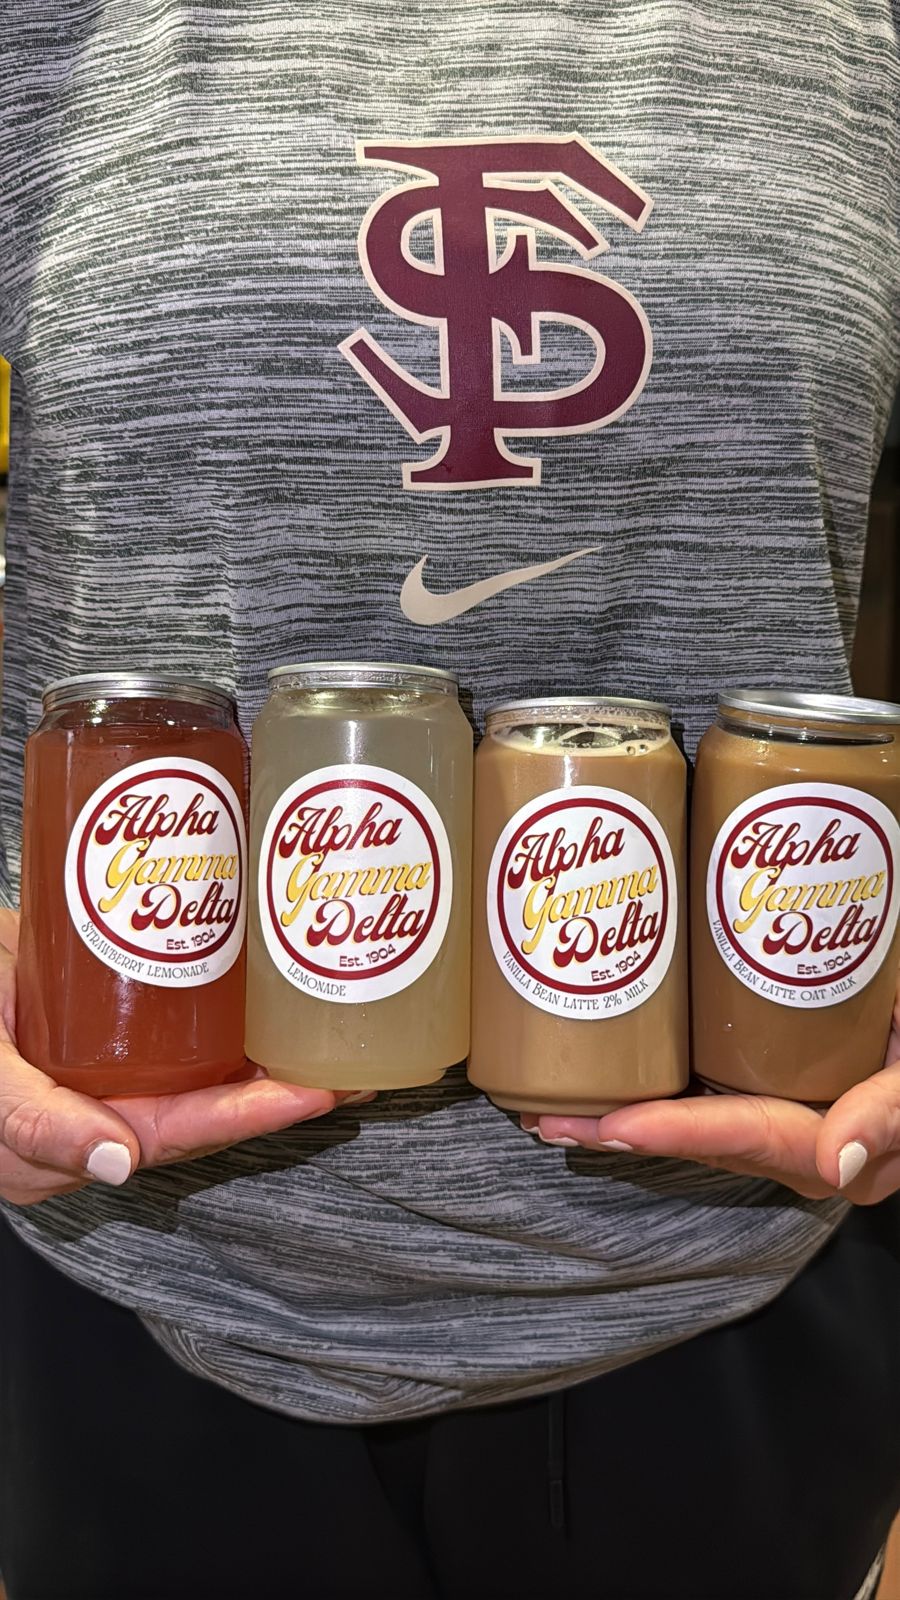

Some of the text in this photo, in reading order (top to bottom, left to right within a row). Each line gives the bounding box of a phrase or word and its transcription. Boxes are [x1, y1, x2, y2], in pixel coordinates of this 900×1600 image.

[94, 794, 219, 857] Alpha
[278, 802, 403, 869] Alpha
[507, 816, 625, 893] Alpha
[730, 818, 861, 884] Alpha
[98, 839, 238, 915] Gamma
[130, 882, 235, 932] Delta
[280, 851, 432, 927] Gamma
[732, 866, 887, 934] Gamma
[166, 930, 216, 950] Est. 1904
[307, 893, 426, 947] Delta
[520, 865, 659, 955] Gamma
[553, 901, 659, 968] Delta
[761, 903, 878, 957] Delta
[80, 921, 209, 980] STRAWBERRY LEMONADE
[287, 962, 346, 997] LEMONADE
[339, 943, 397, 968] Est. 1904
[502, 950, 649, 1010] VANILLA BEAN LATTE 2% MILK
[590, 952, 642, 982] Est. 1904
[712, 919, 857, 1001] VANILLA BEAN LATTE OAT MILK
[796, 952, 852, 975] Est. 1904
